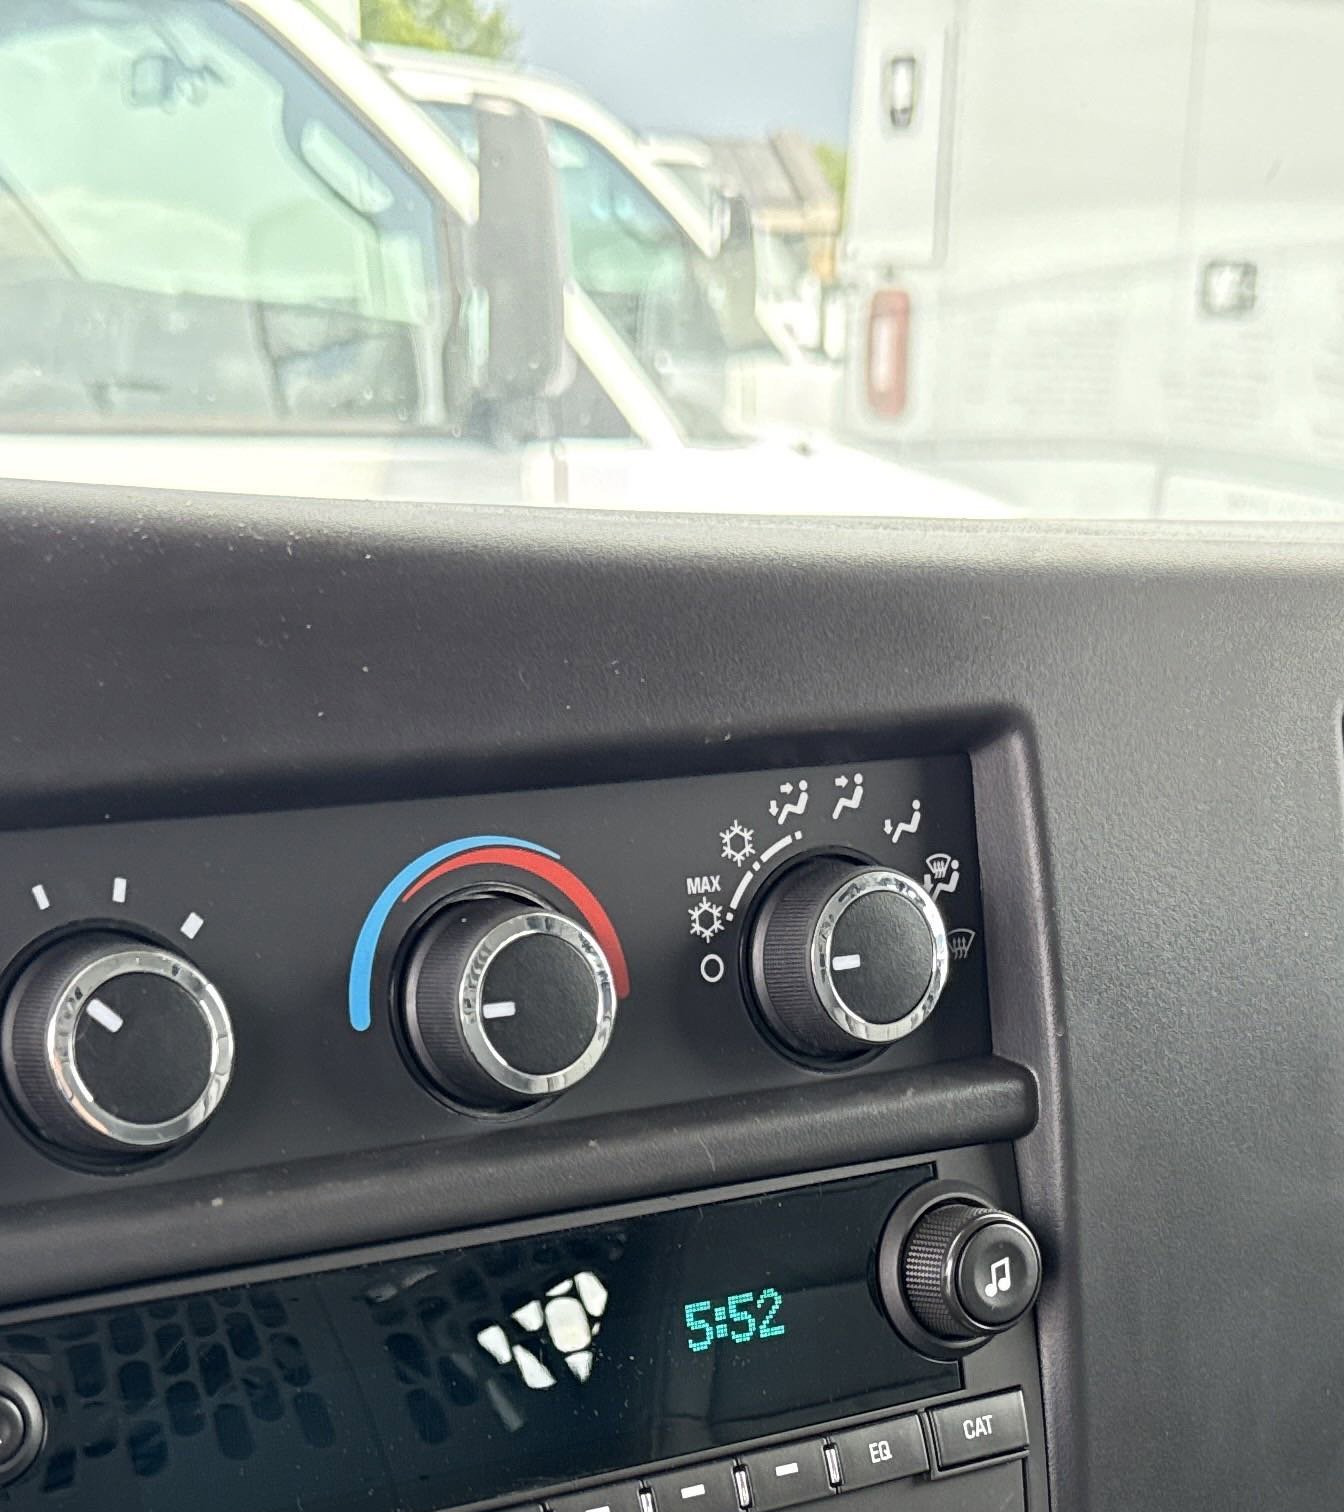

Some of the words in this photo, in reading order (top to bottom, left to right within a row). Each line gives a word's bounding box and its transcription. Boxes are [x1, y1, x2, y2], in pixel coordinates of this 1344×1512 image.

[686, 875, 721, 895] MAX
[684, 1287, 785, 1352] 5:52
[963, 1414, 995, 1440] CAT
[869, 1440, 893, 1464] EQ
